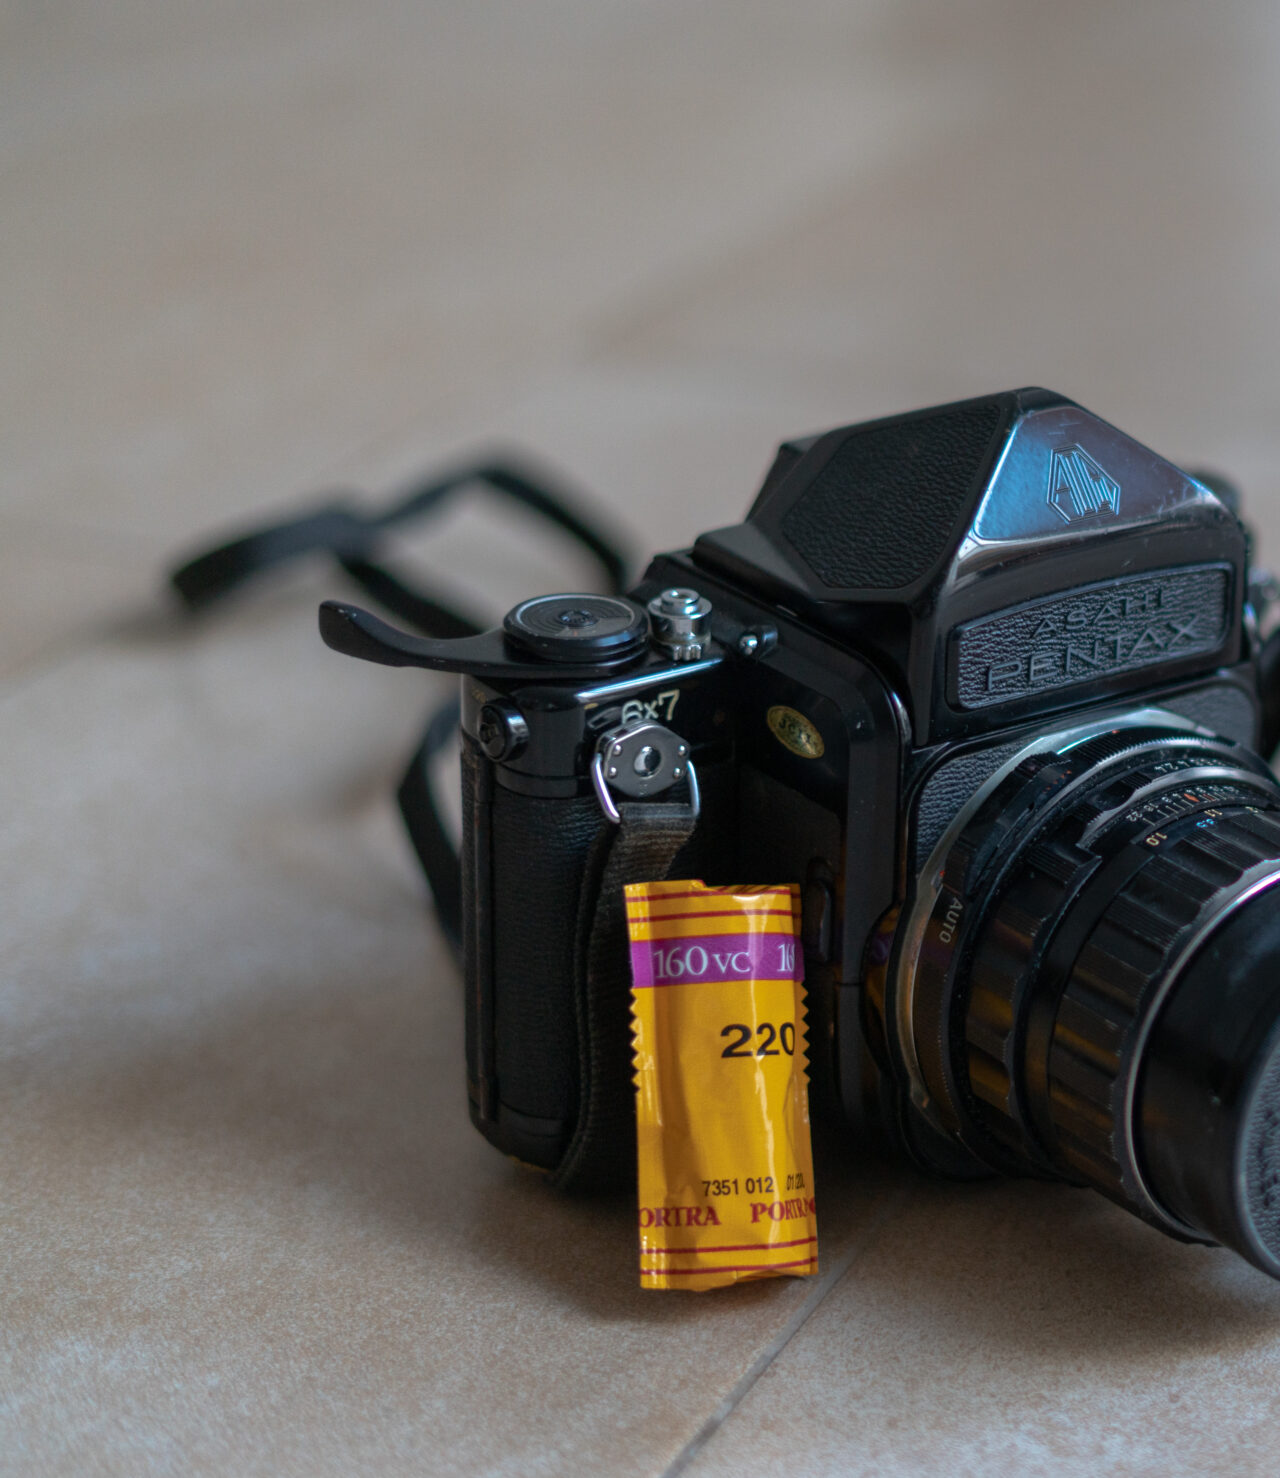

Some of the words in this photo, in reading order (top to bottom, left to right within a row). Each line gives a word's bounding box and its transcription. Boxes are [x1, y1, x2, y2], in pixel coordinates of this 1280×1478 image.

[1030, 588, 1162, 638] ASAHI
[987, 616, 1201, 691] PENTAX
[1146, 832, 1168, 846] 1.0
[939, 897, 963, 943] AUTO
[654, 945, 708, 978] 160
[720, 1022, 795, 1058] 220
[702, 1178, 739, 1197] 7351
[745, 1176, 774, 1194] 012
